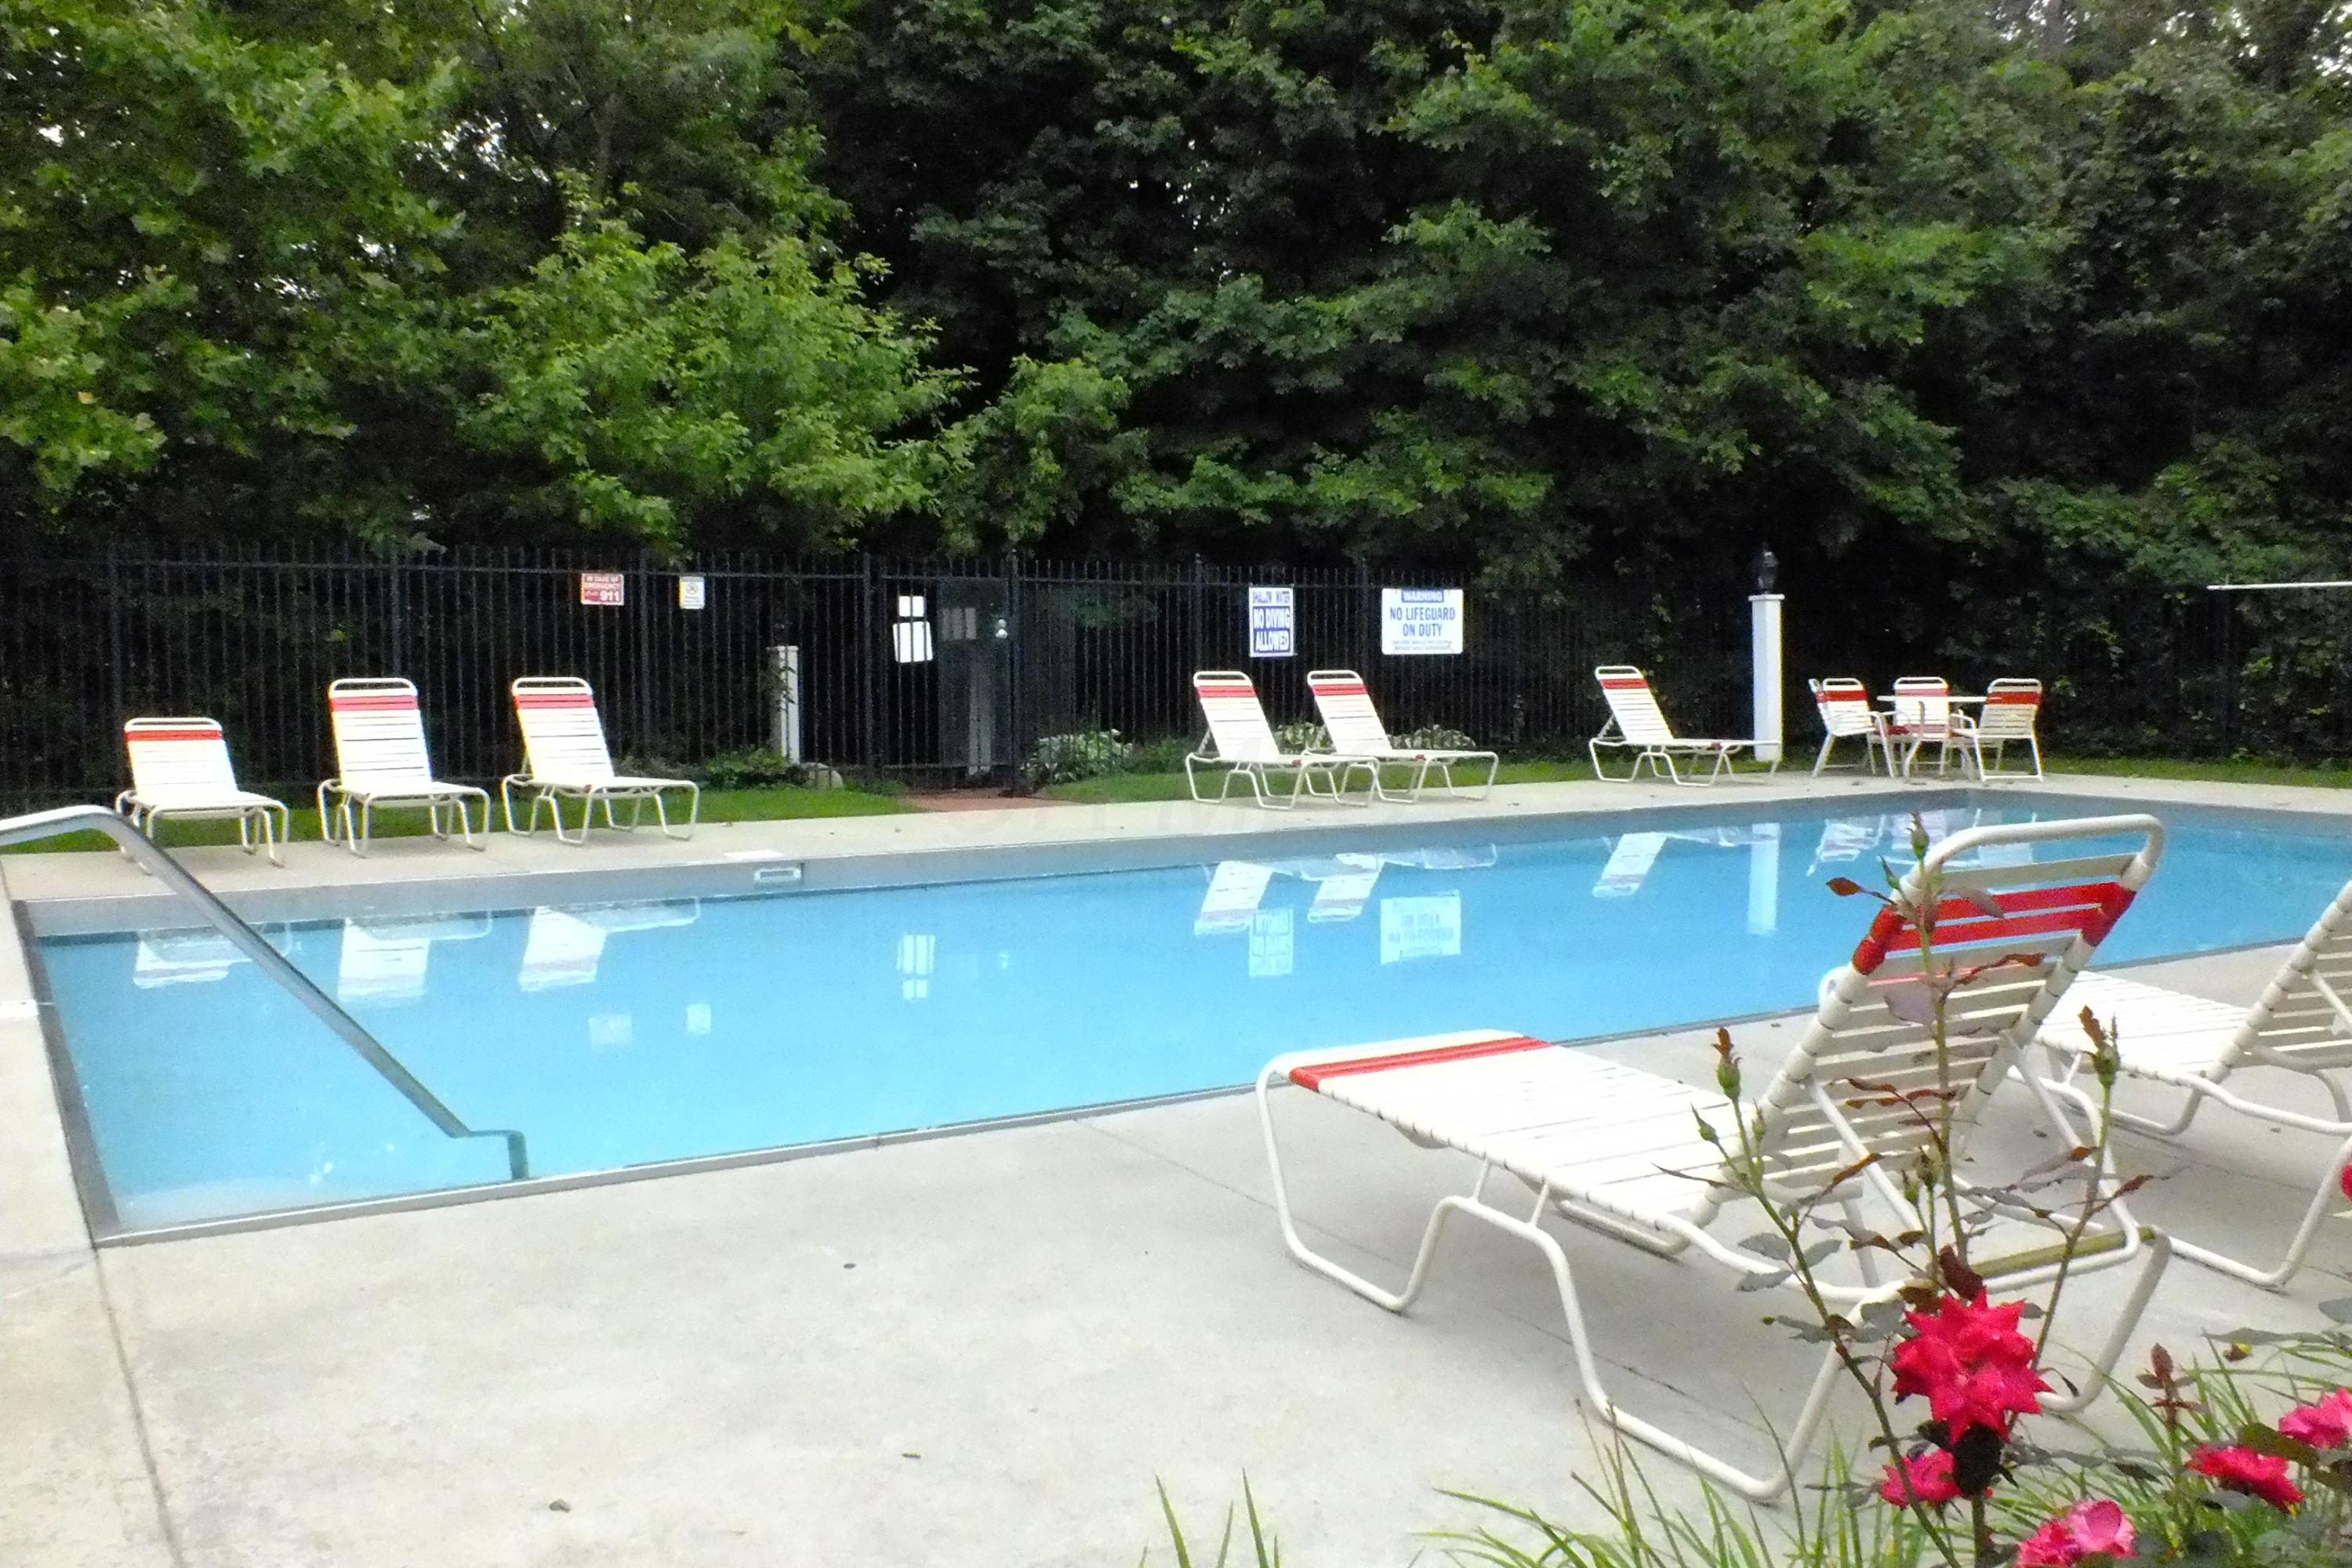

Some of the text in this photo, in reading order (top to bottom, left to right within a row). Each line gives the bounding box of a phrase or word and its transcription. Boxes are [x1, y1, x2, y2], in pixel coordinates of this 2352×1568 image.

[600, 590, 620, 601] 911
[1254, 608, 1265, 629] NO
[1390, 606, 1456, 621] NO LIFEGUARD
[1403, 622, 1443, 637] ON DUTY
[1255, 630, 1290, 651] ALLOWED
